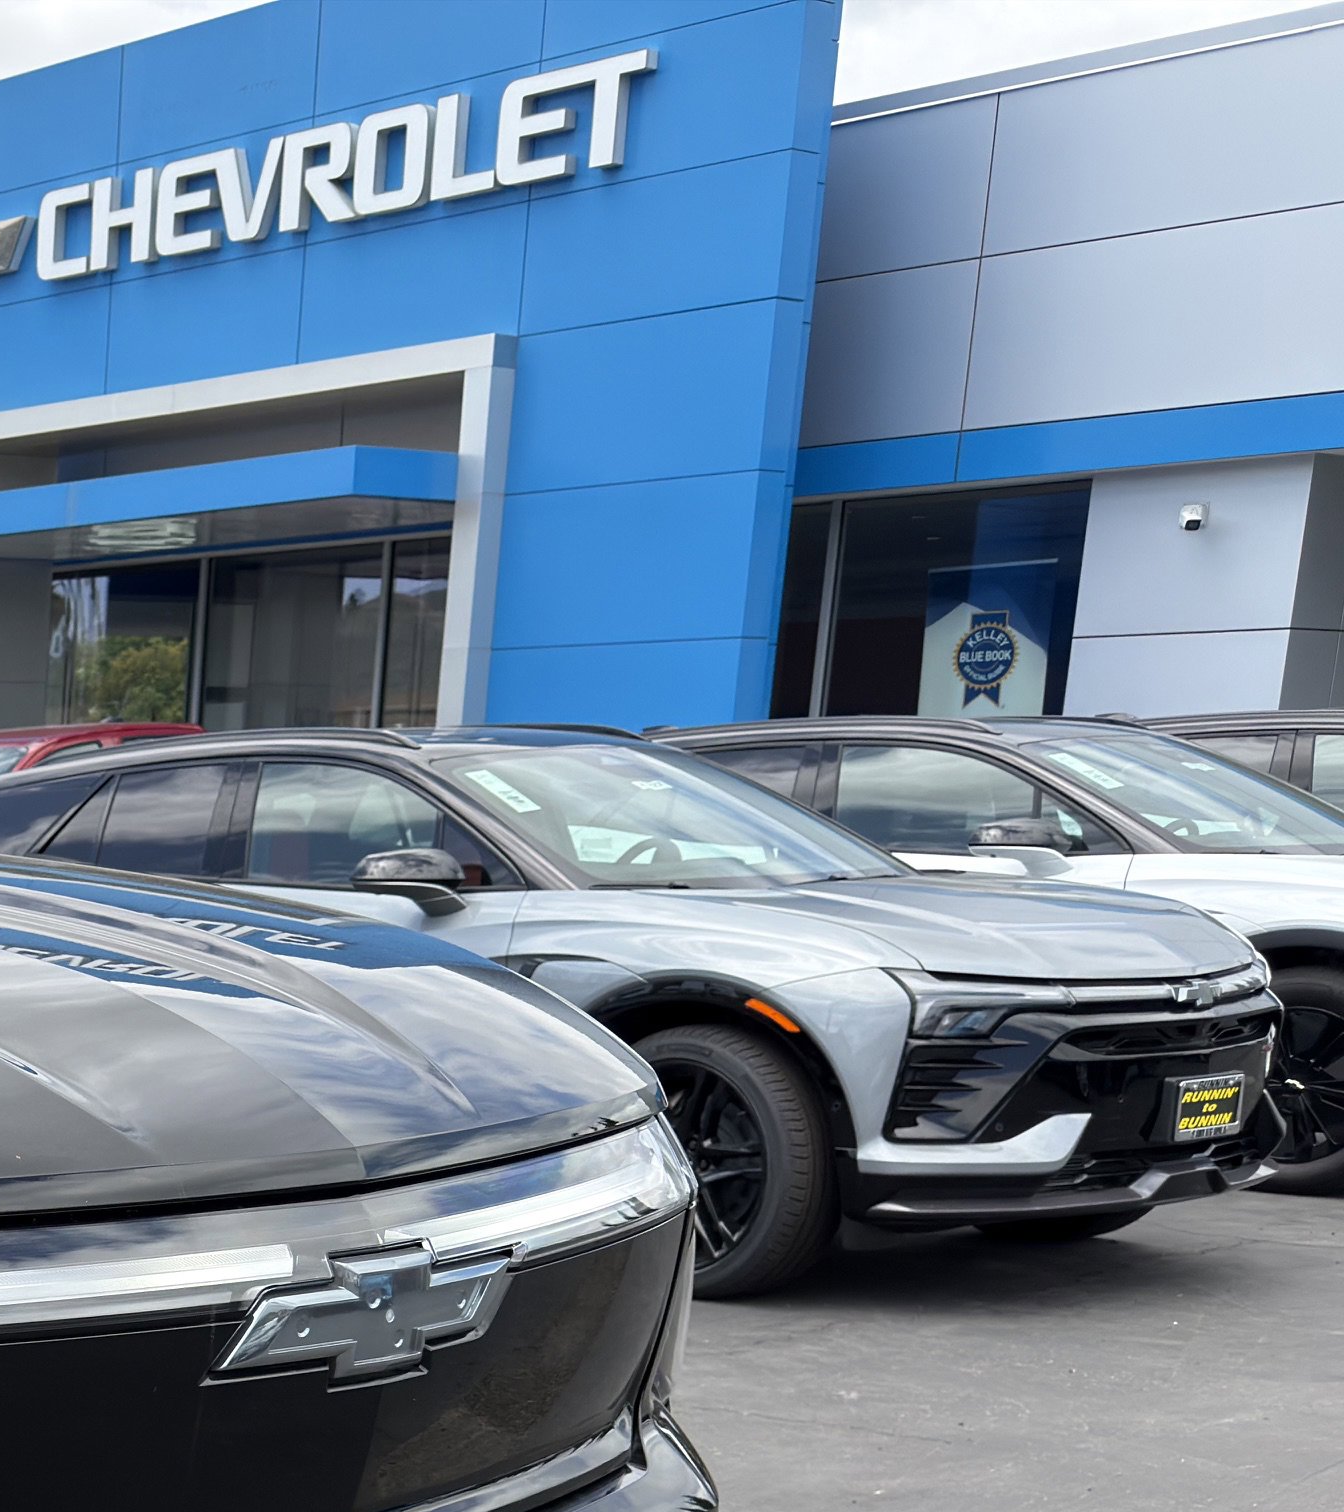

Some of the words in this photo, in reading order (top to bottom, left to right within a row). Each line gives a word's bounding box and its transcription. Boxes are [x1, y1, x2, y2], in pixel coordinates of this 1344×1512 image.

[37, 48, 656, 280] CHEVROLET
[967, 630, 1010, 647] KELLEY
[959, 651, 985, 663] BLUE
[985, 650, 1012, 662] BOOK
[1202, 1103, 1217, 1112] to
[1179, 1113, 1232, 1129] BUNNIN
